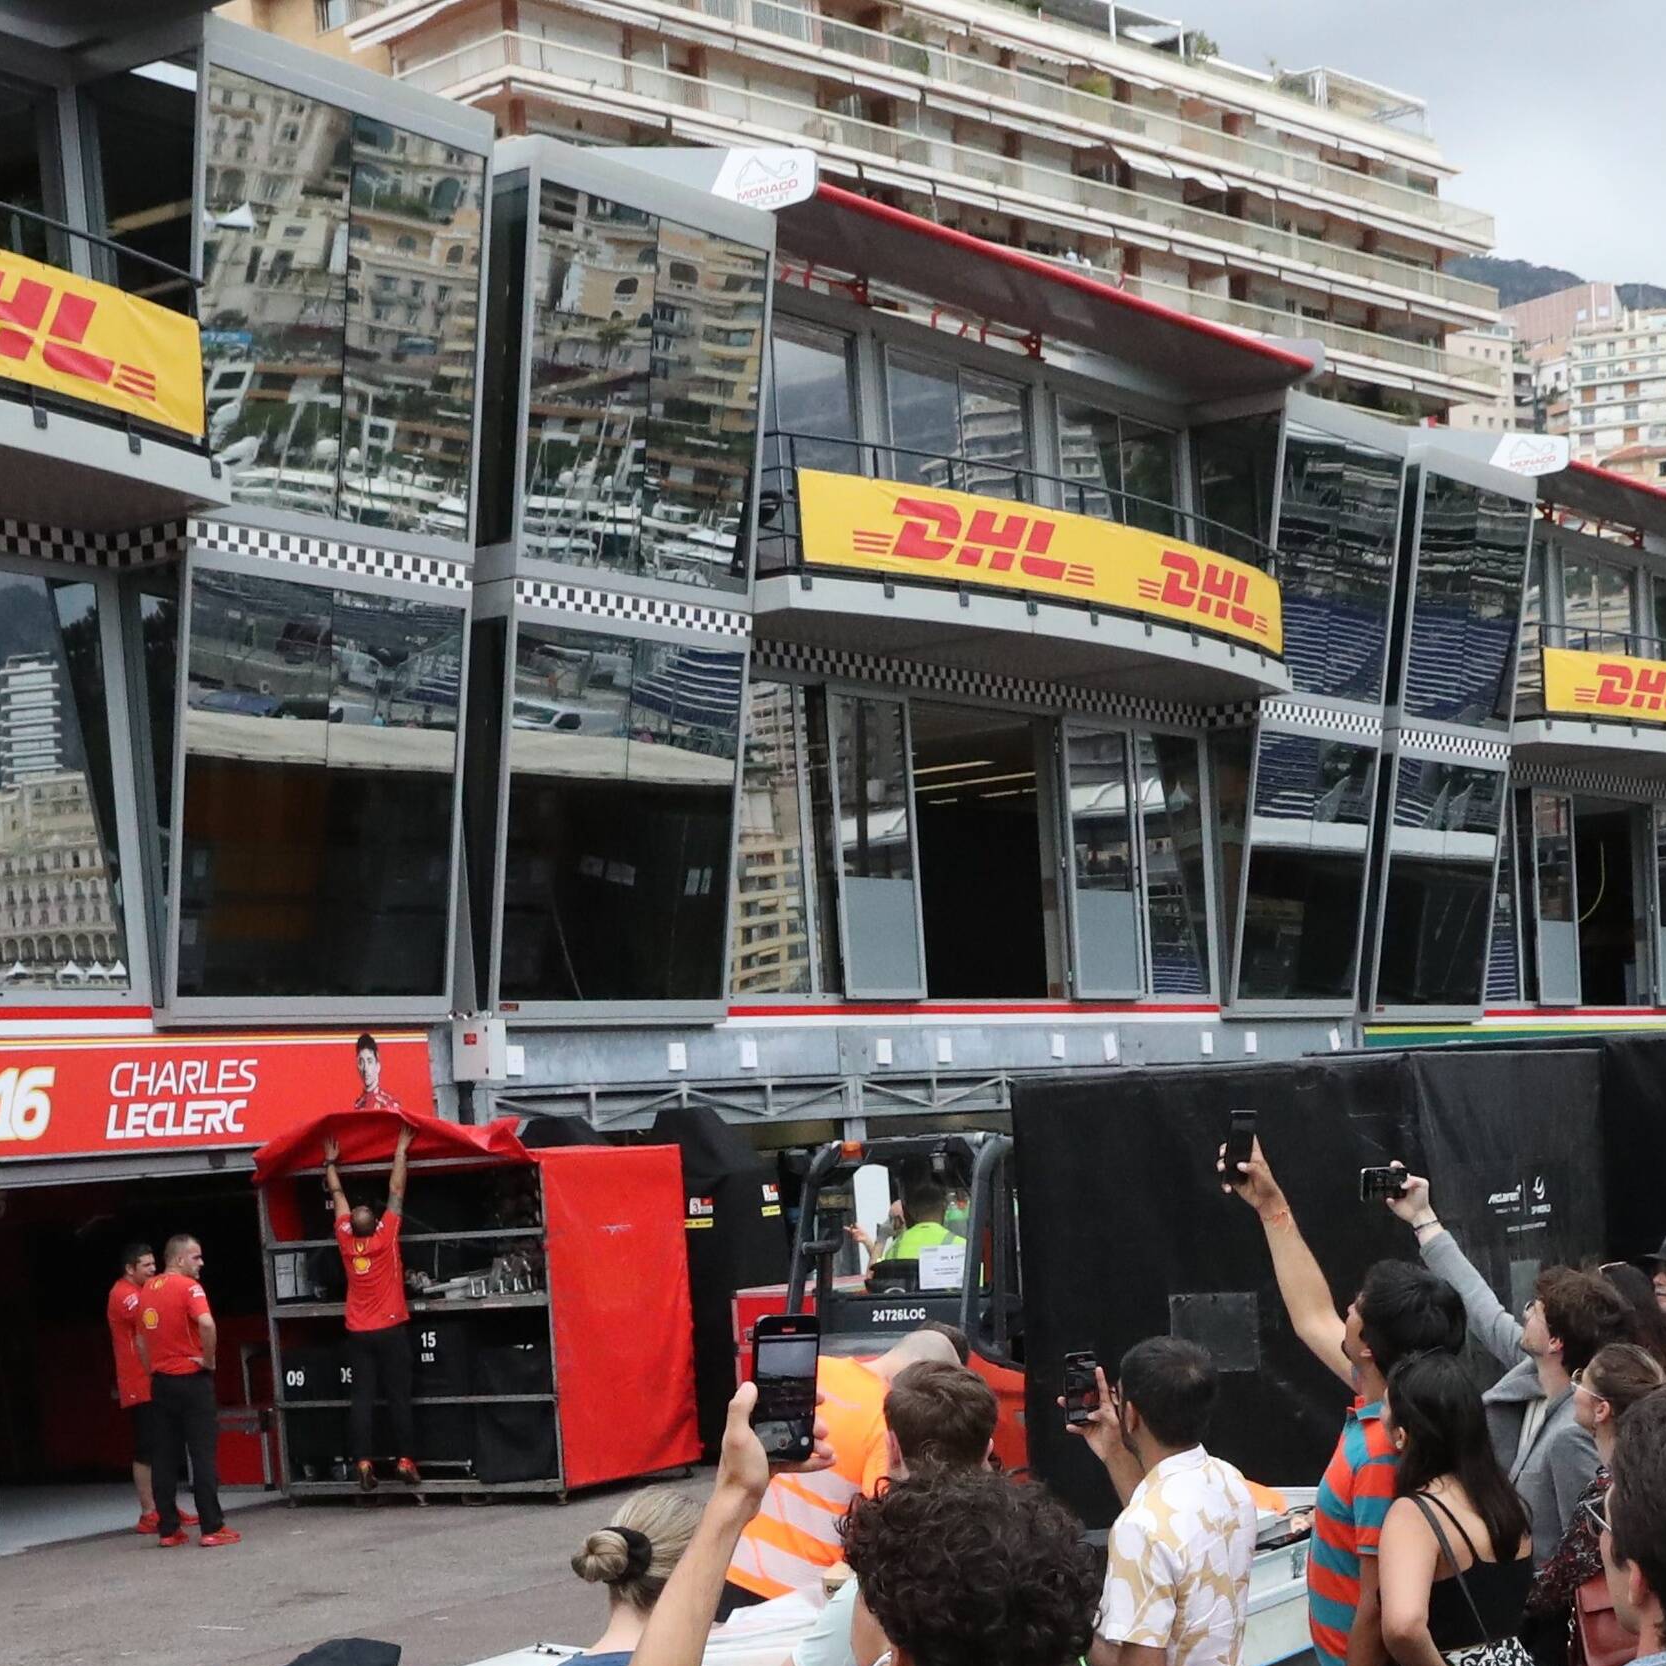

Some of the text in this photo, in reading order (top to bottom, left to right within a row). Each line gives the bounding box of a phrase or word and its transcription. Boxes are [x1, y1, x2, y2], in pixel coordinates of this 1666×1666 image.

[737, 179, 798, 200] MONACO
[892, 497, 1067, 580] DHL
[1161, 550, 1256, 629] DHL
[109, 1058, 258, 1098] CHARLES
[105, 1099, 248, 1139] LECLERC
[872, 1308, 926, 1322] 24726LOC
[421, 1331, 436, 1348] 15
[286, 1370, 305, 1387] 09
